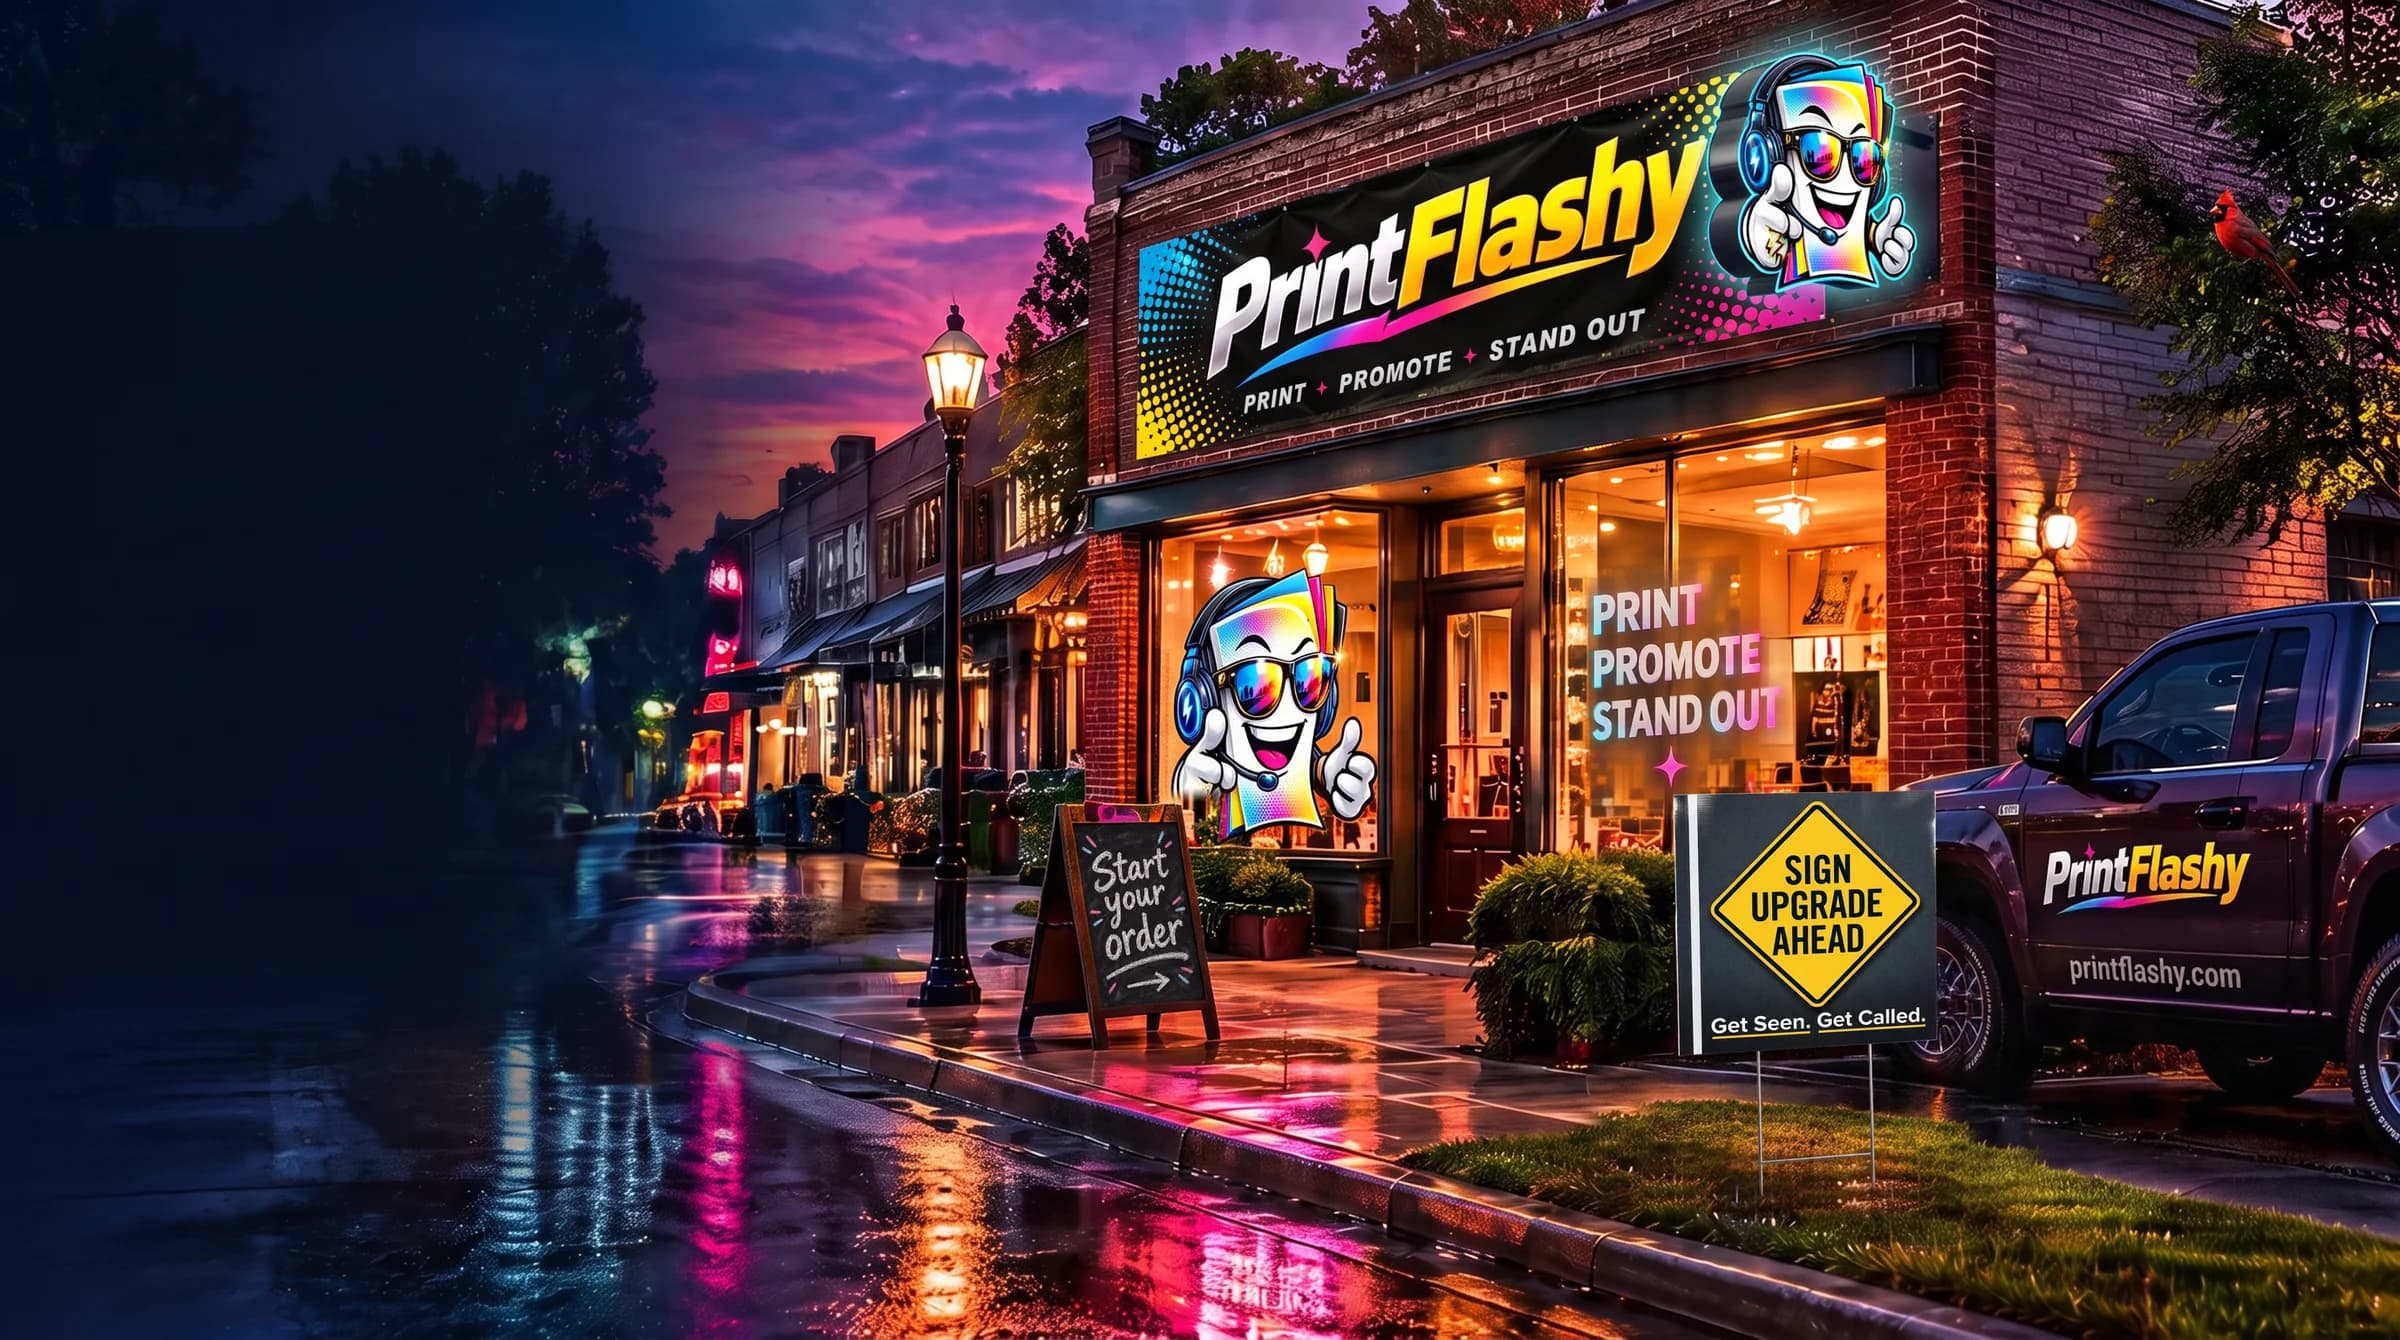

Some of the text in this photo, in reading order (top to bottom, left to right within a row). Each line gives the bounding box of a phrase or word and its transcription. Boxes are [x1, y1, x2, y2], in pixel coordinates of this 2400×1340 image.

[1206, 136, 1707, 380] PrintFlashy
[1243, 308, 1646, 414] PRINT PROMOTE STAND OUT
[1593, 583, 1703, 636] PRINT
[1593, 633, 1761, 688] PROMOTE
[1592, 686, 1782, 741] STAND OUT
[1091, 848, 1169, 893] Start
[1785, 854, 1851, 885] SIGN
[2043, 841, 2251, 906] PrintFlashy
[1104, 884, 1165, 929] your
[1751, 888, 1883, 921] UPGRADE
[1105, 912, 1183, 960] order
[1772, 924, 1864, 956] AHEAD
[2069, 955, 2242, 992] printflashy.com
[1711, 1007, 1927, 1035] Get Seen. Get Called.
